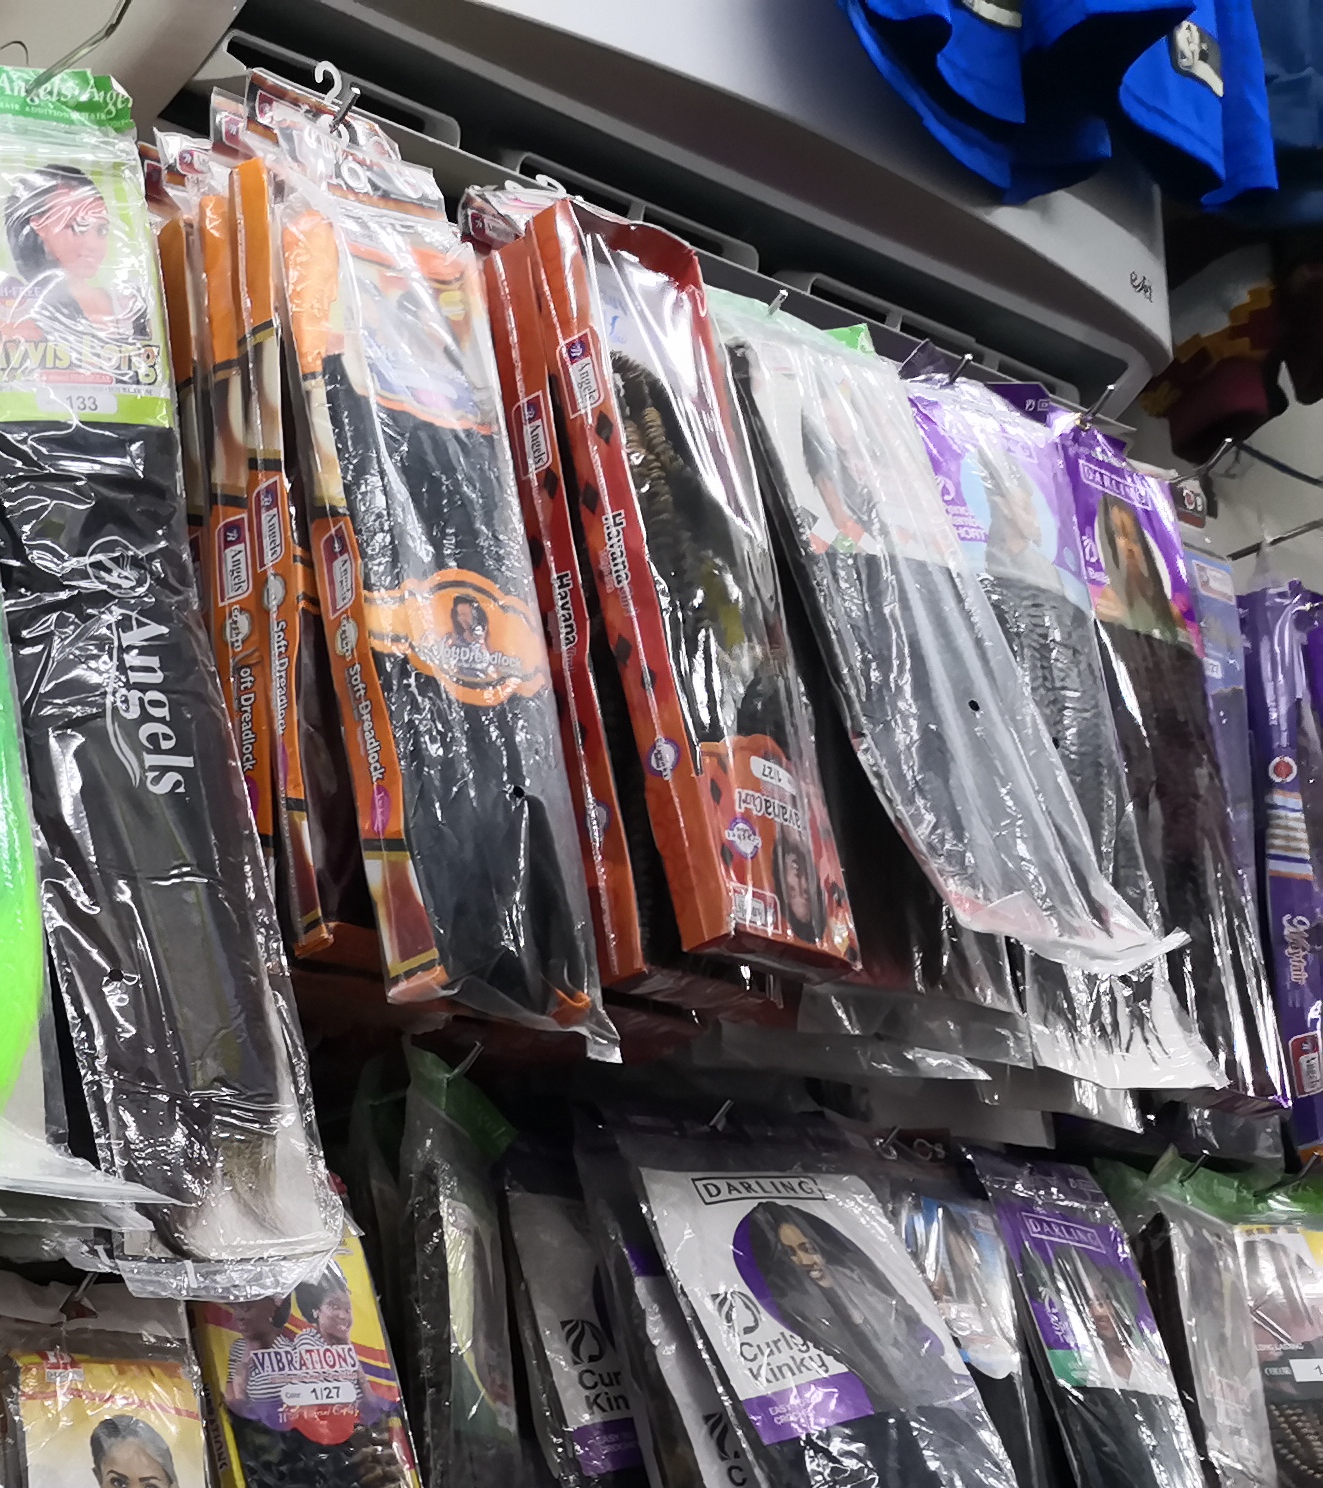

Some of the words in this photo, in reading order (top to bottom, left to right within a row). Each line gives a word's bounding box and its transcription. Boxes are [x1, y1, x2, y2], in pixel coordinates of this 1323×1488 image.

[67, 395, 100, 413] 133
[527, 422, 547, 467] Angels
[224, 545, 245, 602] Angels
[554, 572, 577, 647] Havana
[114, 606, 198, 796] Angels
[239, 689, 257, 772] Dreadlock
[347, 662, 366, 701] Soft
[358, 701, 386, 784] Dreadlock
[705, 1179, 815, 1199] DARLING
[253, 1345, 357, 1376] VIBRATIONS
[739, 1330, 812, 1364] Curly
[746, 1351, 830, 1385] Kinky
[310, 1386, 341, 1401] 1/27
